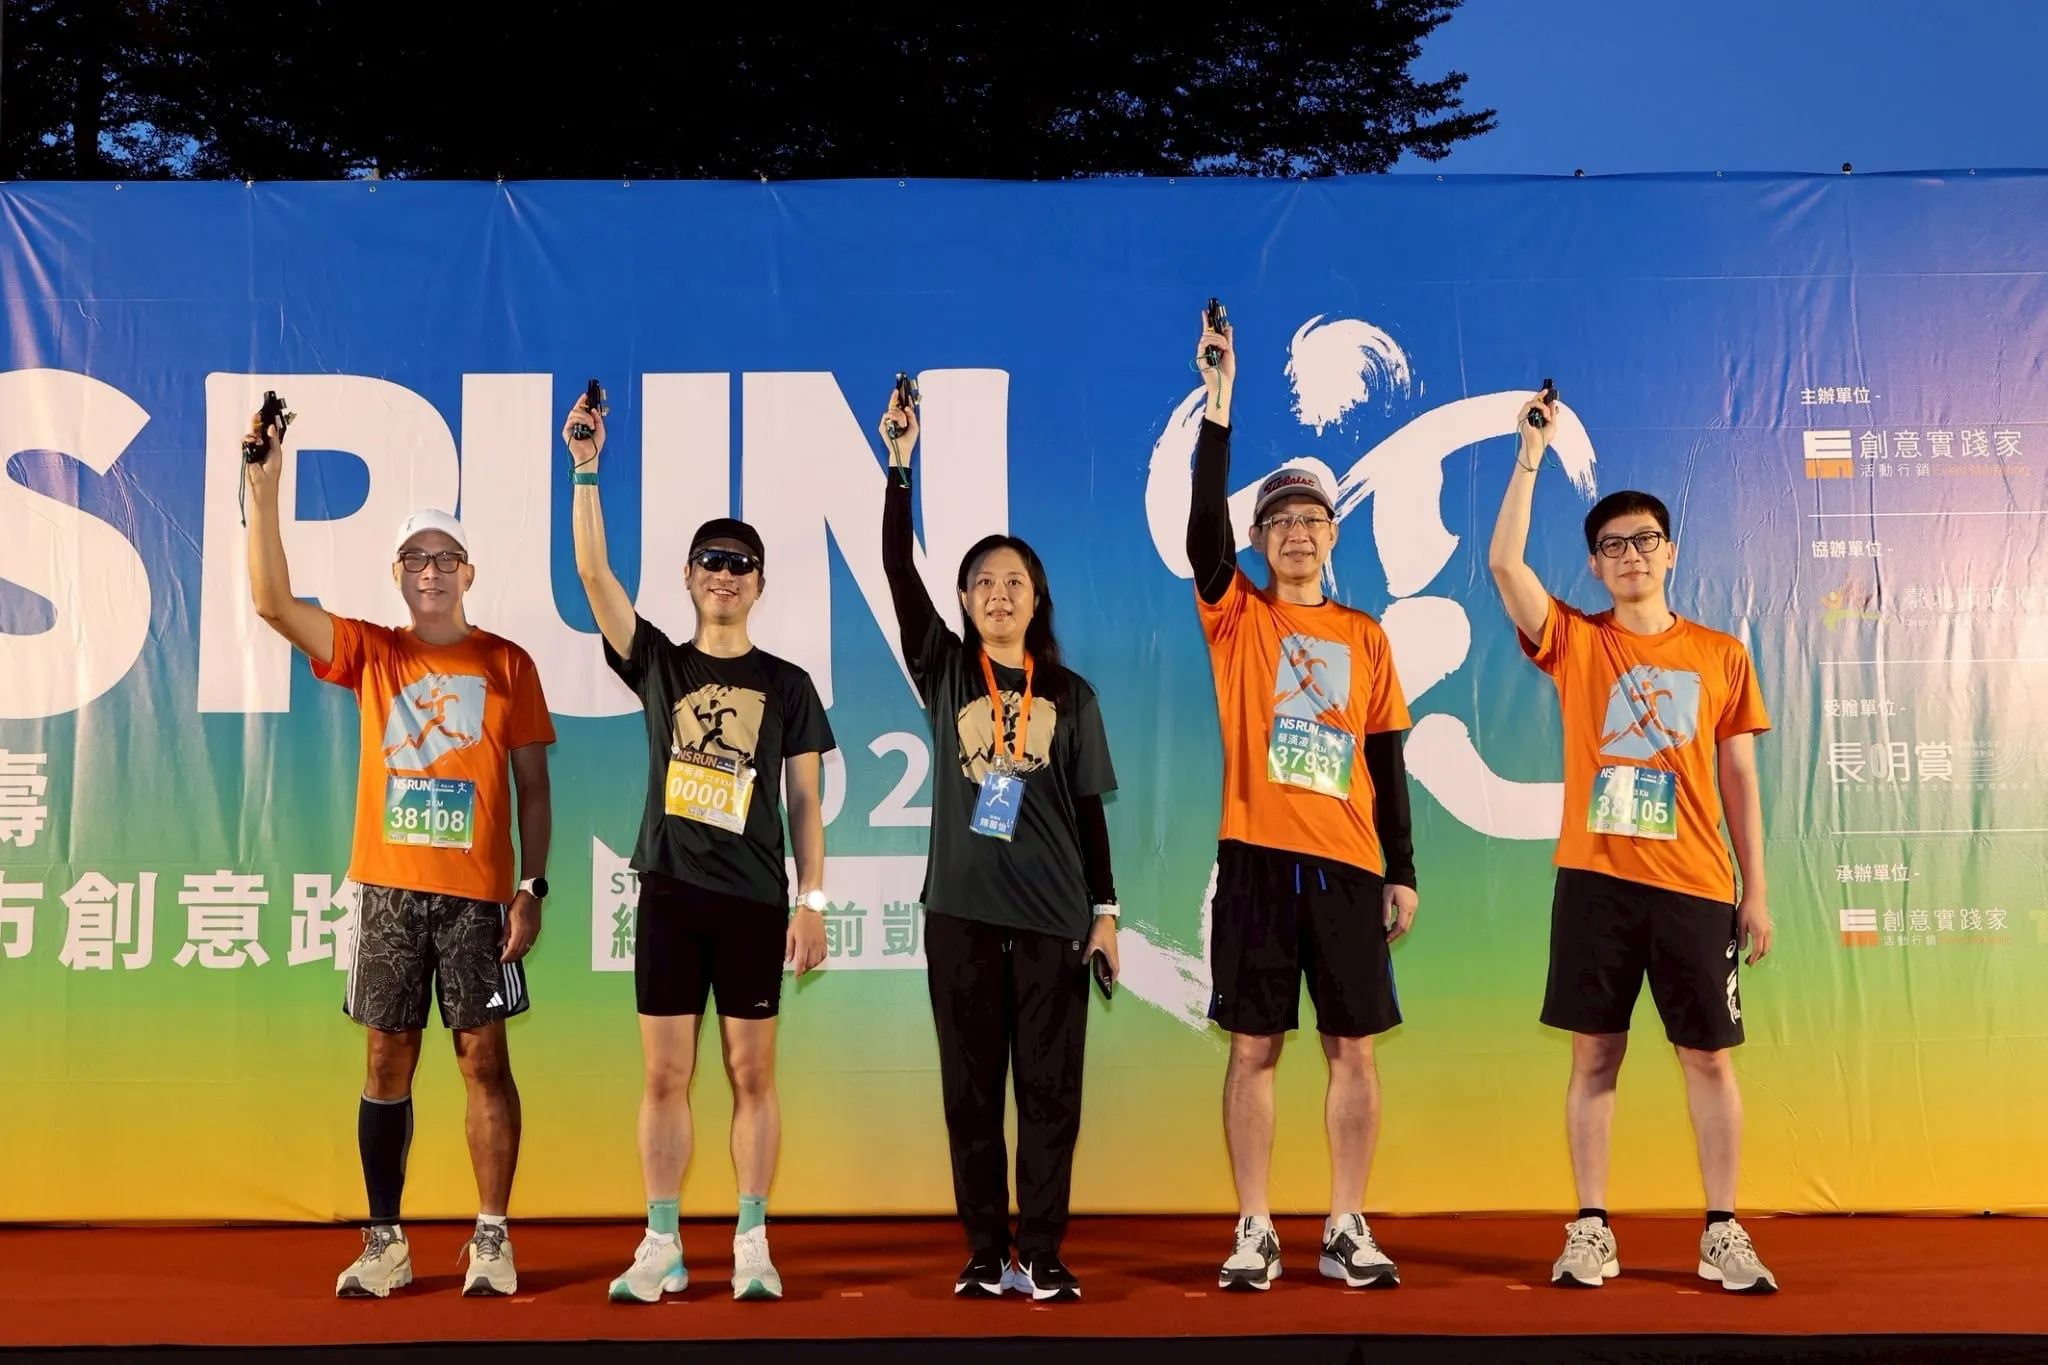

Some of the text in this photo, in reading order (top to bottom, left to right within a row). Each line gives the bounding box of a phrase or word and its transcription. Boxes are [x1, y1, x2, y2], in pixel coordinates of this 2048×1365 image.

[1859, 429, 2023, 459] 創意實踐家
[1827, 741, 1952, 783] 長明賞
[390, 806, 465, 833] 38108
[1882, 908, 2009, 932] 創意實踐家
